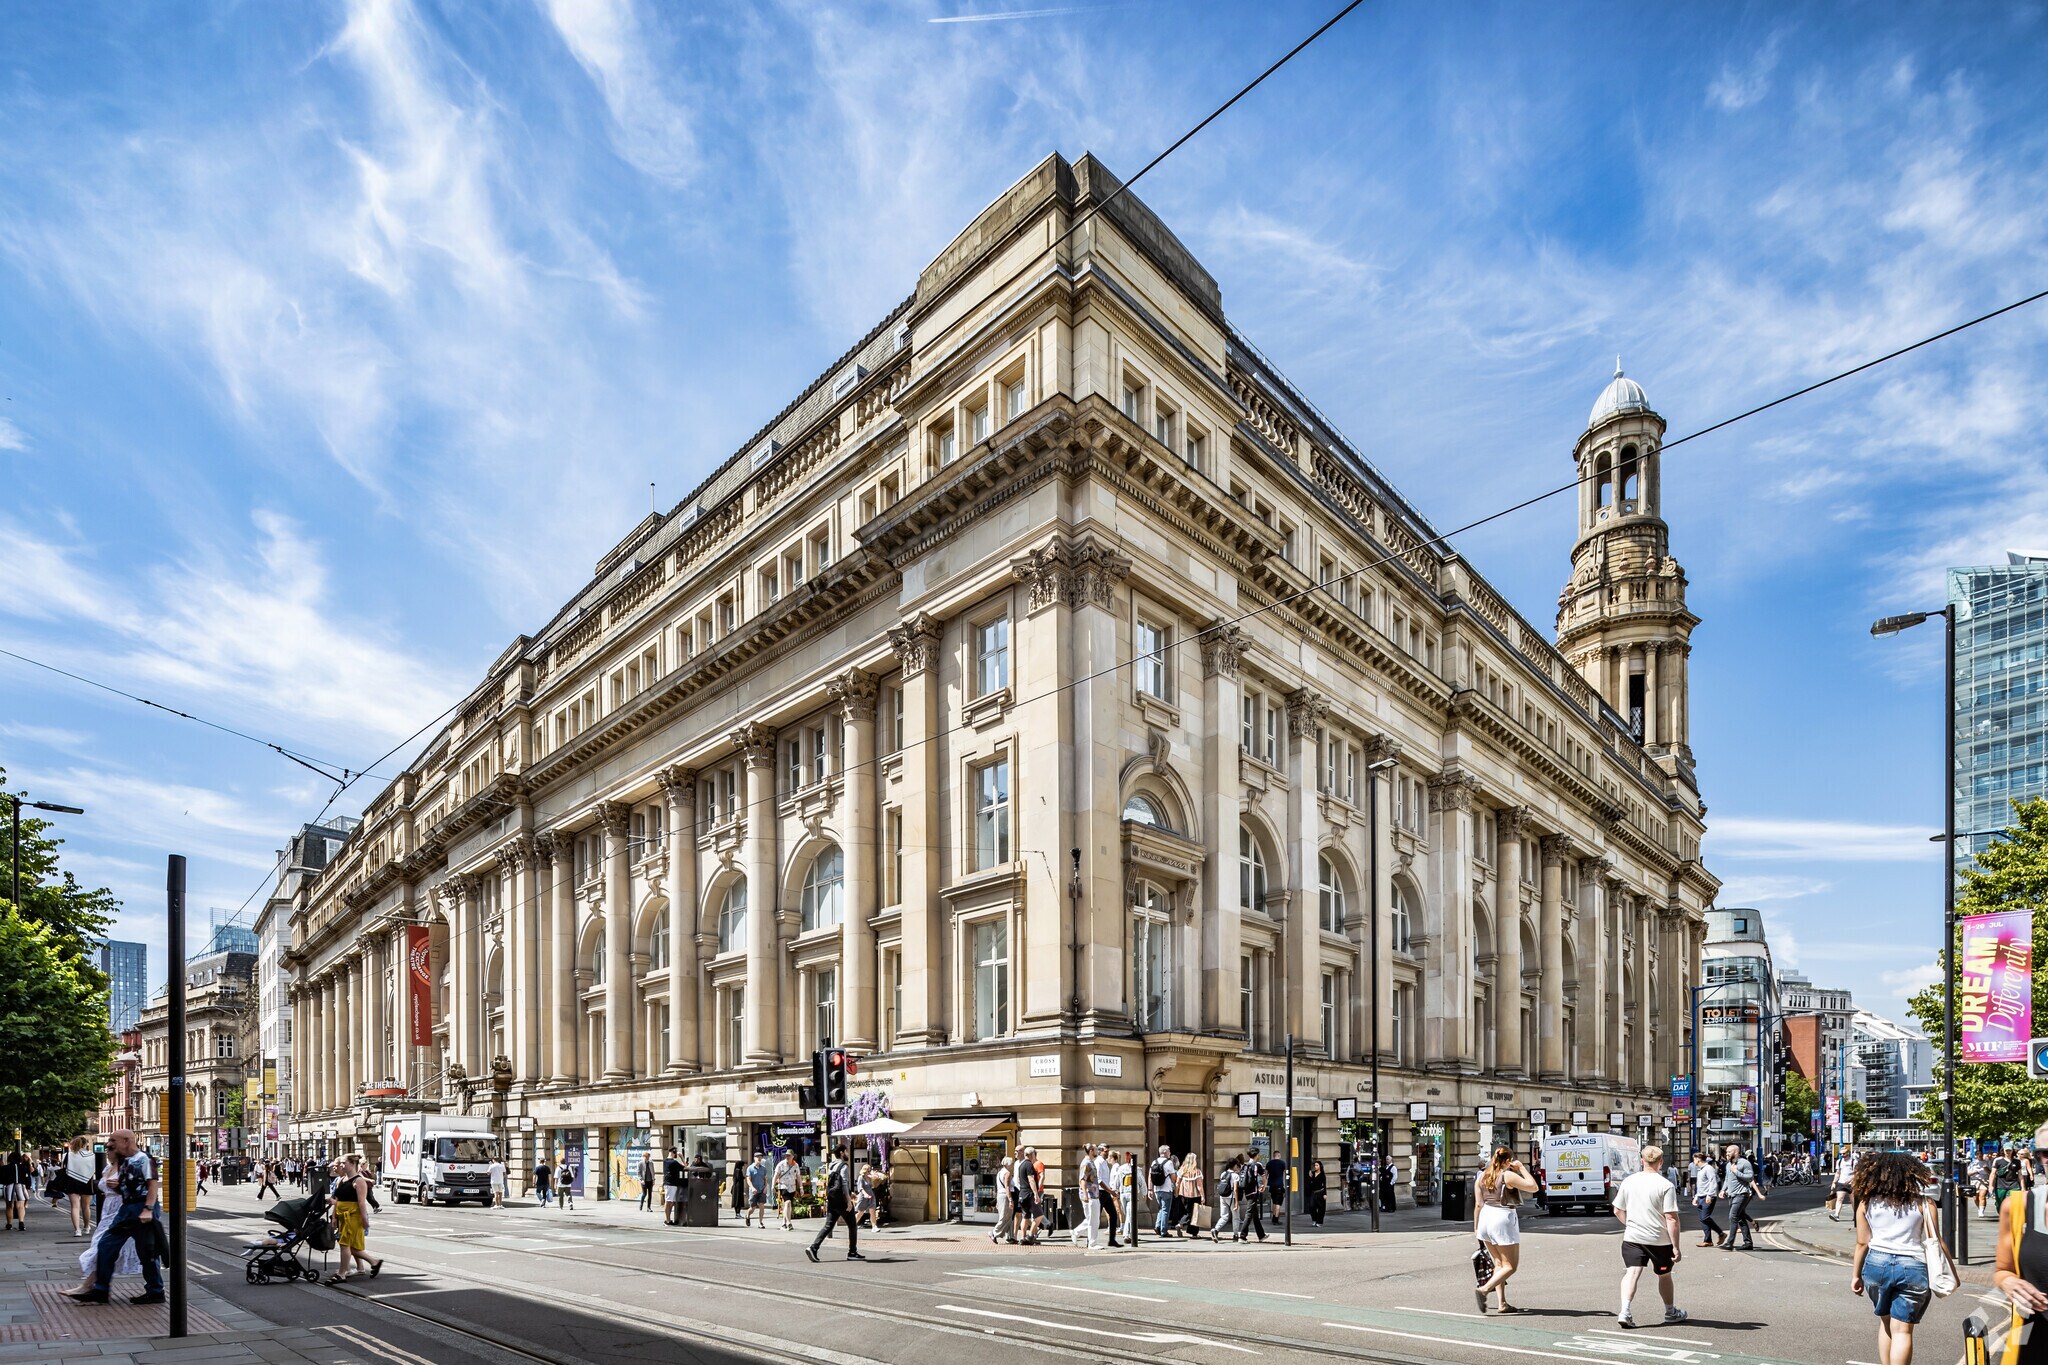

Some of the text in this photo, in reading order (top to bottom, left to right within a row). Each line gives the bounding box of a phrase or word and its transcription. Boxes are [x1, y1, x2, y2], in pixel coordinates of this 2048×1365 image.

[410, 946, 418, 971] THEATRE
[420, 948, 428, 967] ROYAL
[416, 952, 430, 980] EXCHANGE
[1962, 937, 1999, 1033] DREAM
[1986, 937, 2031, 1033] Differently
[1705, 1009, 1721, 1018] TO
[1724, 1008, 1741, 1017] LET
[1965, 1041, 2002, 1053] MIF
[1255, 1073, 1316, 1087] ASTRID MIYU
[1420, 1124, 1444, 1136] scribbler
[402, 1134, 415, 1159] dpd
[1551, 1138, 1597, 1147] JAFVANS
[1565, 1150, 1582, 1159] CAR
[1558, 1158, 1590, 1169] RENTAL
